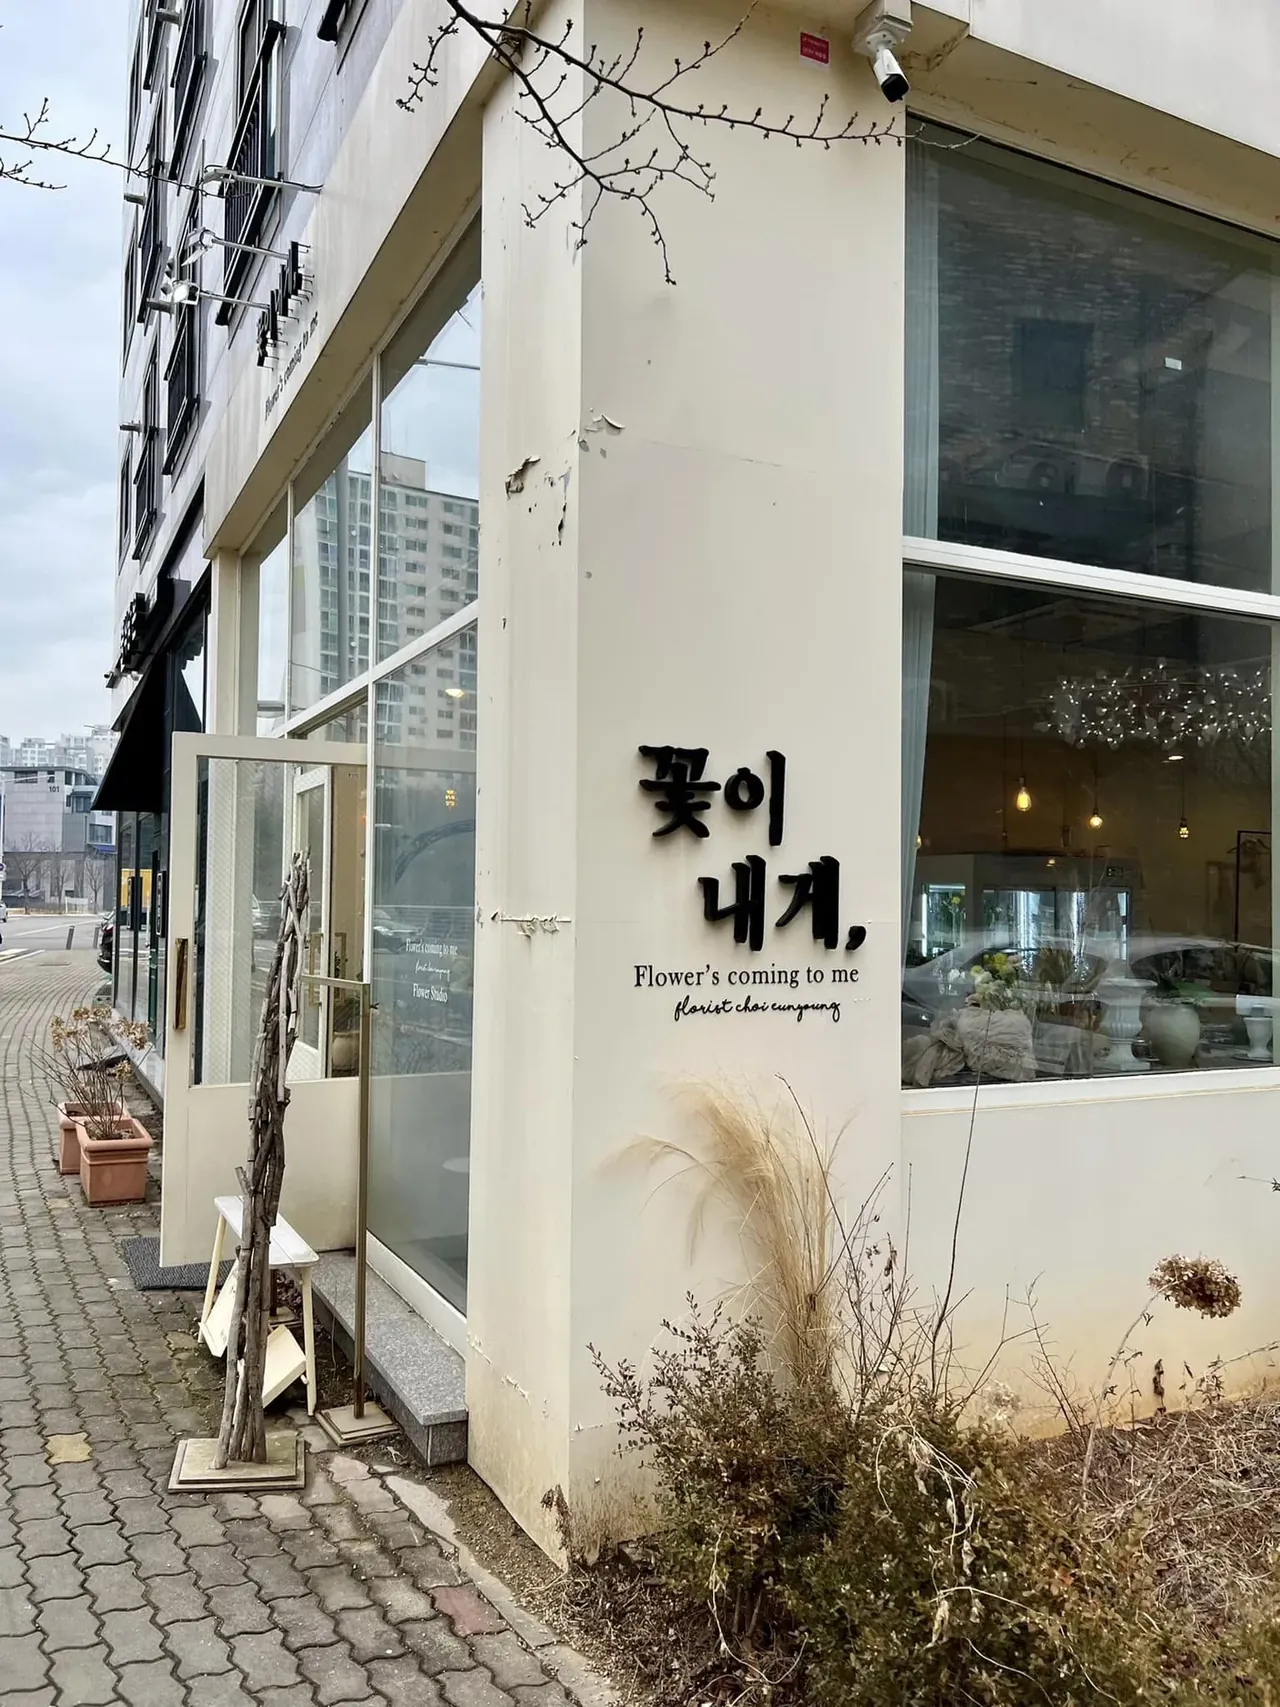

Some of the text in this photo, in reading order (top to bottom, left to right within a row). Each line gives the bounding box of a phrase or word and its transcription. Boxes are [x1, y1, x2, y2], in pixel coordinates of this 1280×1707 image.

[638, 745, 786, 847] 꽃이
[697, 854, 867, 952] 내게,
[633, 963, 859, 989] Flower's coming to me
[413, 983, 448, 1003] Flower Studio
[674, 995, 841, 1023] florist choi eunyoung
